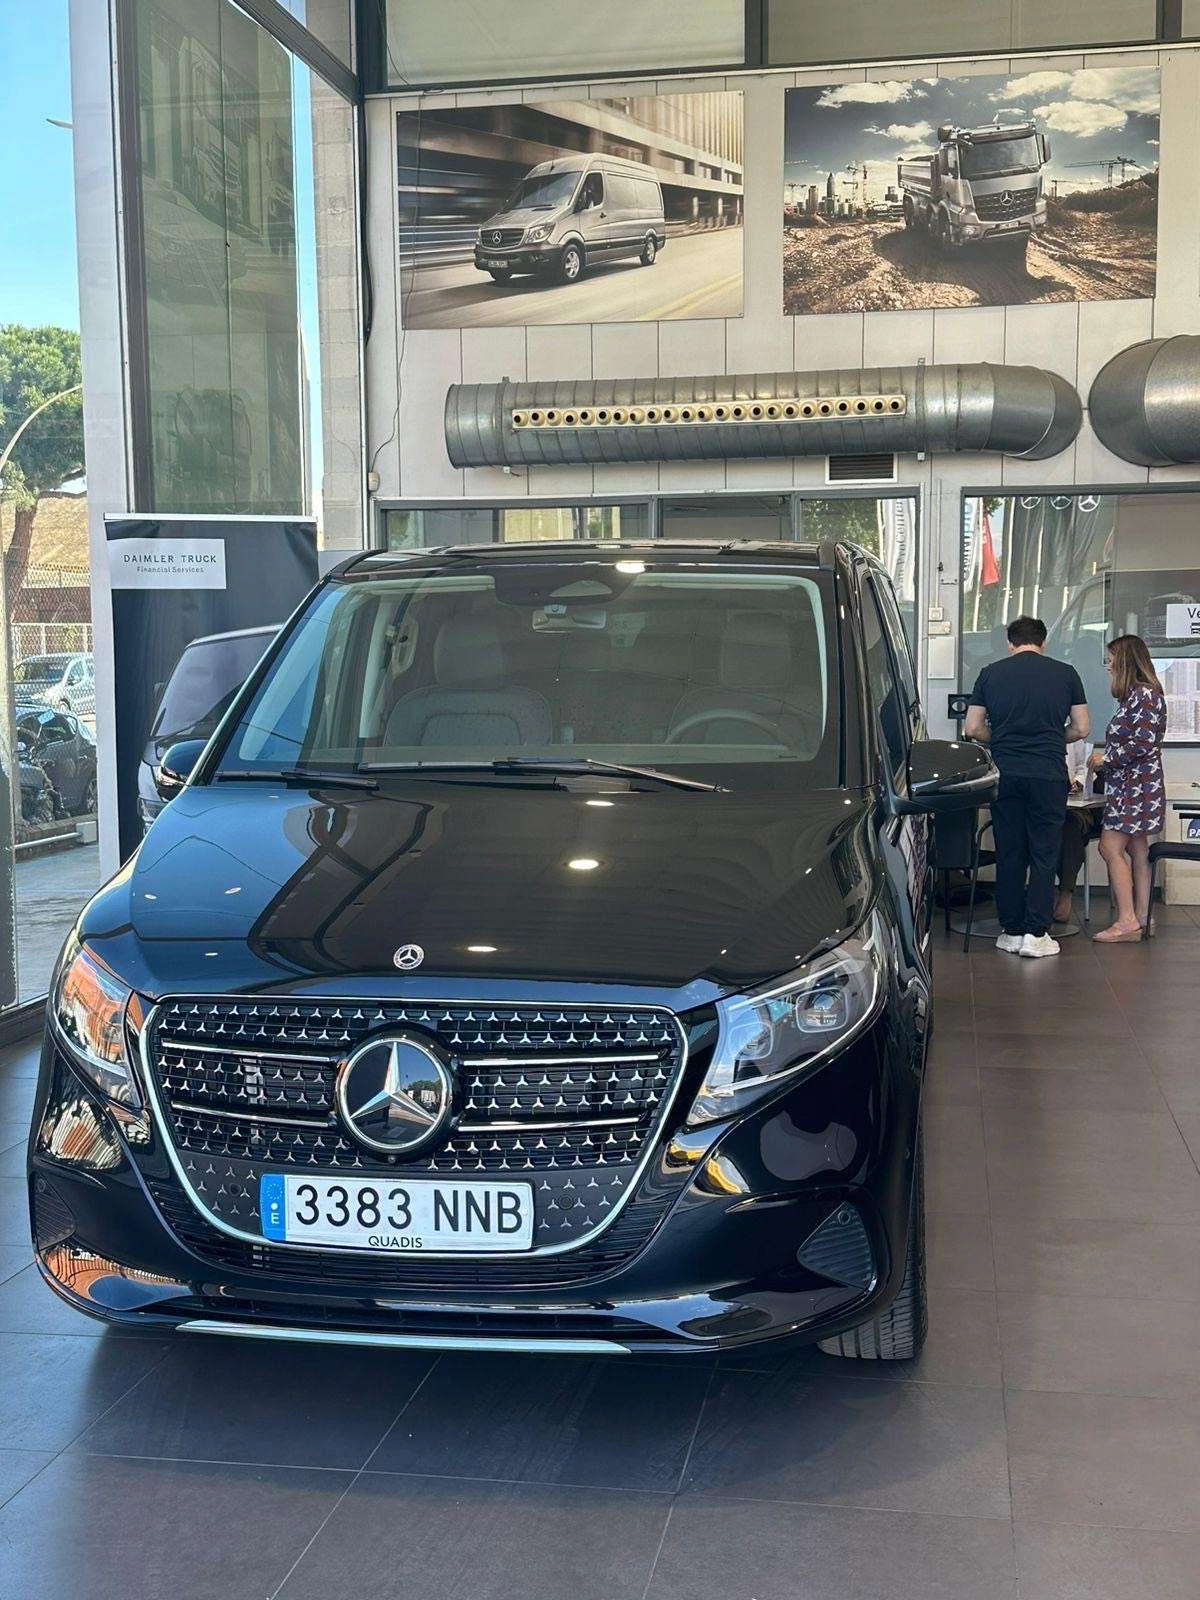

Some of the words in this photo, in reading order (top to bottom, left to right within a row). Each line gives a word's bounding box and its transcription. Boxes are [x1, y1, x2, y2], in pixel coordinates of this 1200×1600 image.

[123, 554, 174, 563] DAIMLER
[181, 554, 217, 563] TRUCK
[295, 1183, 412, 1229] 3383
[433, 1189, 523, 1234] NNB
[270, 1212, 280, 1225] E
[368, 1235, 423, 1249] QUADIS
